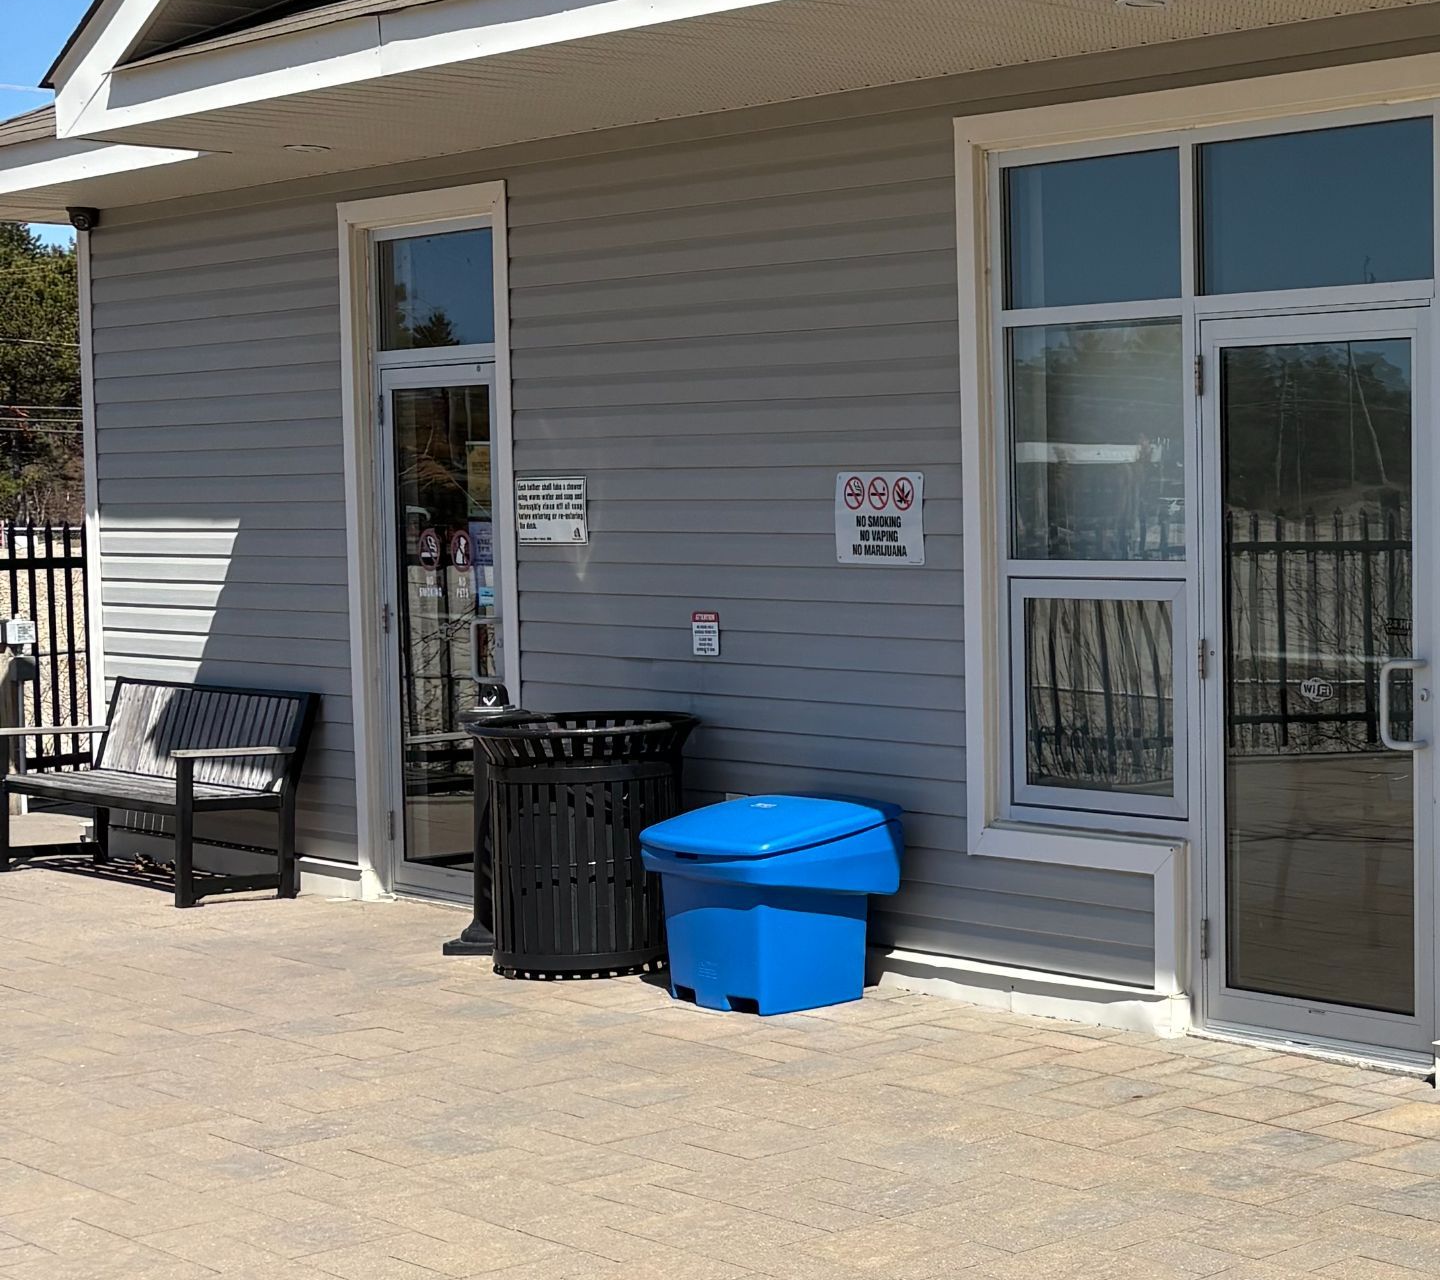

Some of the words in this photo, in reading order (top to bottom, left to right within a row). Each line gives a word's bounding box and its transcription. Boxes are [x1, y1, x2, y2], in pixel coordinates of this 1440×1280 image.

[856, 515, 867, 528] NO
[867, 515, 902, 528] SMOKING
[860, 530, 870, 541] NO
[872, 530, 899, 542] VAPING
[852, 544, 863, 555] NO
[864, 544, 907, 557] MARIJUANA
[458, 575, 467, 587] NO
[456, 587, 469, 598] PETS
